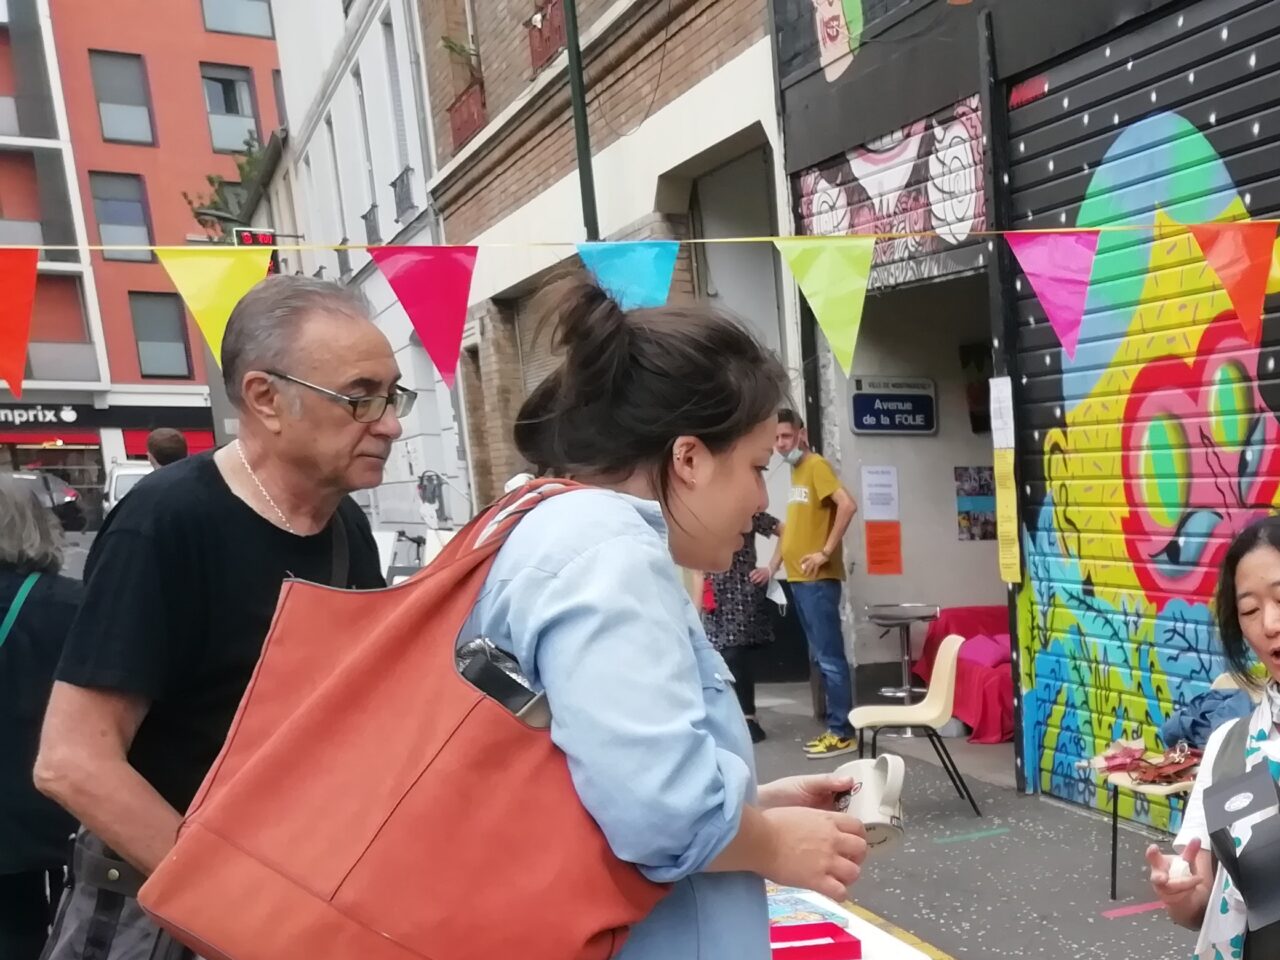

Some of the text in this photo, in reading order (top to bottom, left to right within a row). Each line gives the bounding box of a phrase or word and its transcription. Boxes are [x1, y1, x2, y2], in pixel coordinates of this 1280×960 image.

[874, 398, 912, 410] Avenue
[863, 414, 925, 425] de la FOLIE
